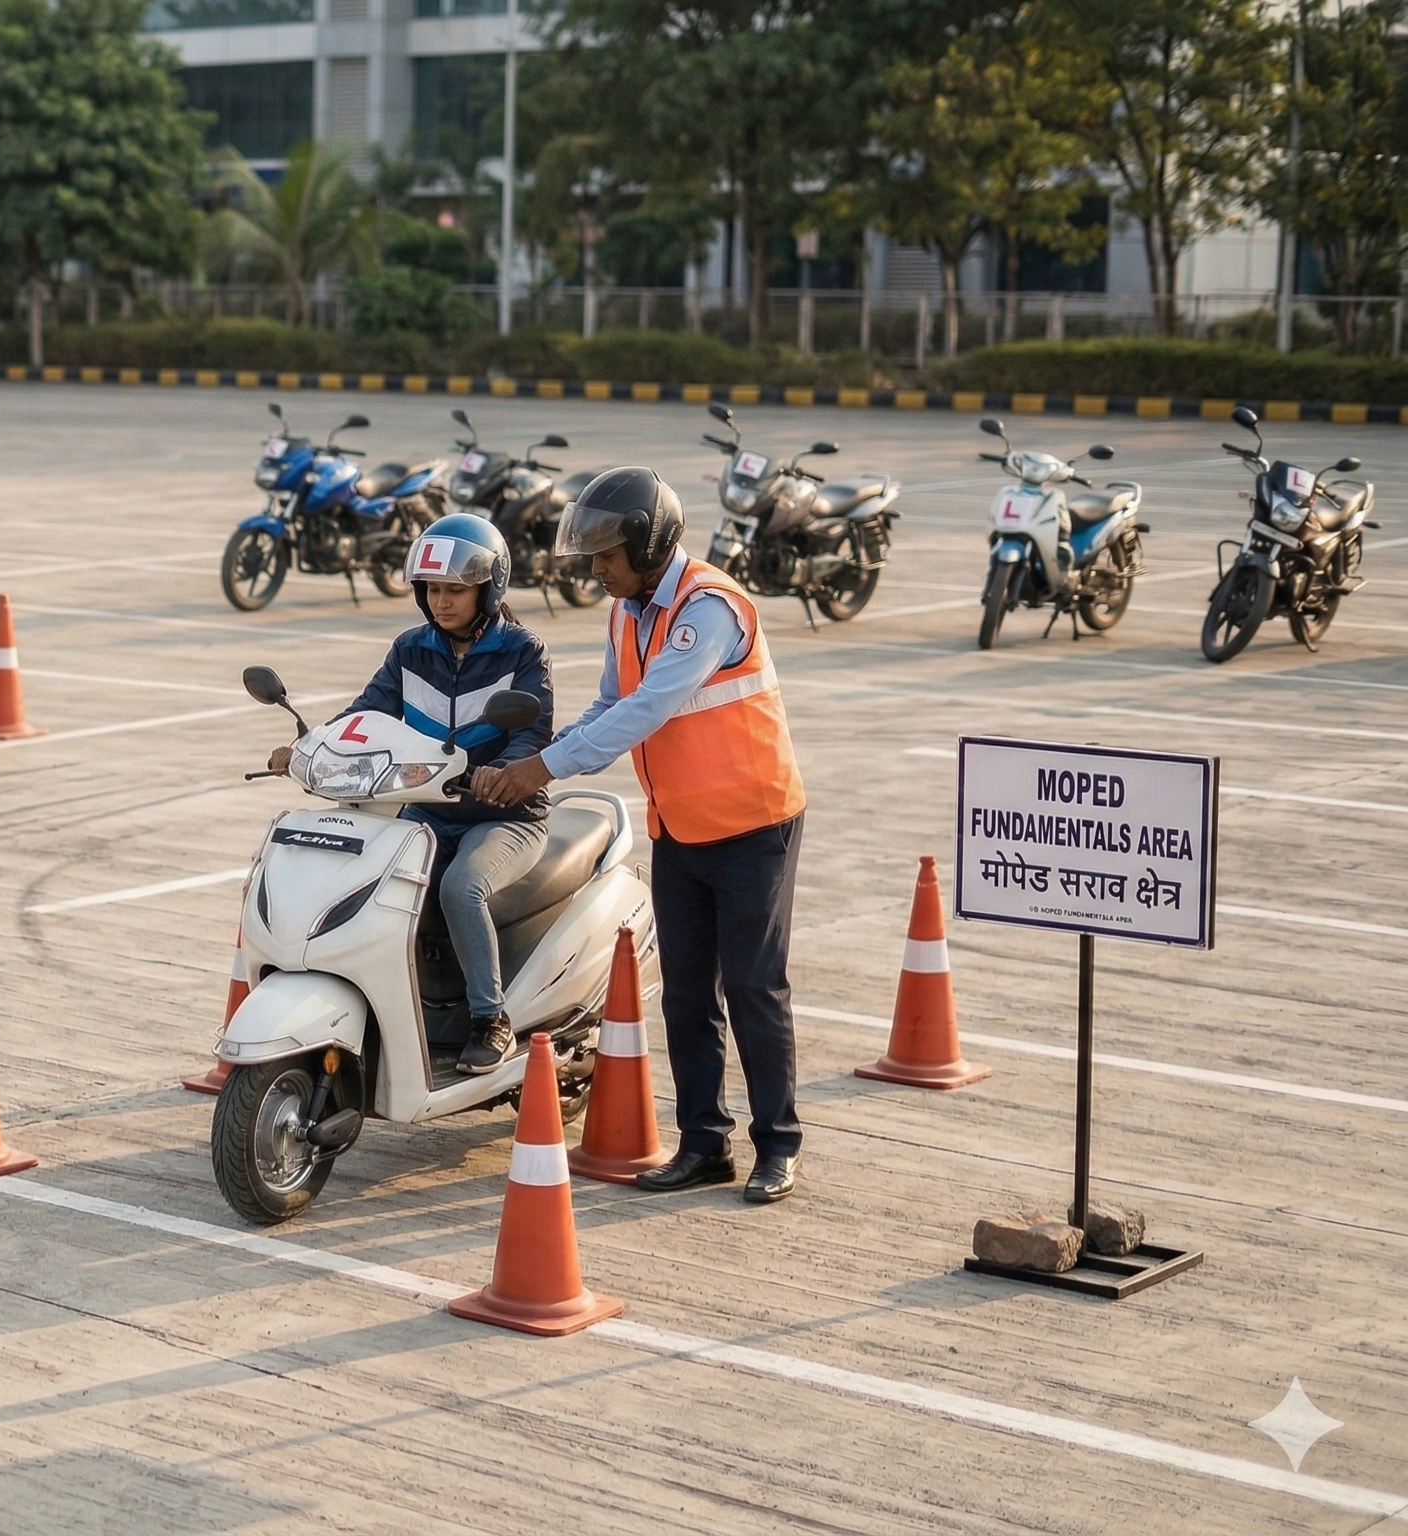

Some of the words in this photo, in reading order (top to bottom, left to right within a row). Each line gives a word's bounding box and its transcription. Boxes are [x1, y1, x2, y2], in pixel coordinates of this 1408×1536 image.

[1293, 471, 1306, 488] L
[1003, 500, 1020, 519] L
[419, 543, 442, 570] L
[680, 628, 690, 643] L
[338, 716, 369, 744] L
[1037, 768, 1125, 808] MOPED
[971, 808, 1132, 853] FUNDAMENTALS
[1137, 825, 1193, 861] AREA
[980, 850, 1051, 893] मोपेड
[1058, 868, 1127, 903] सराव
[1135, 868, 1182, 910] क्षेत्र
